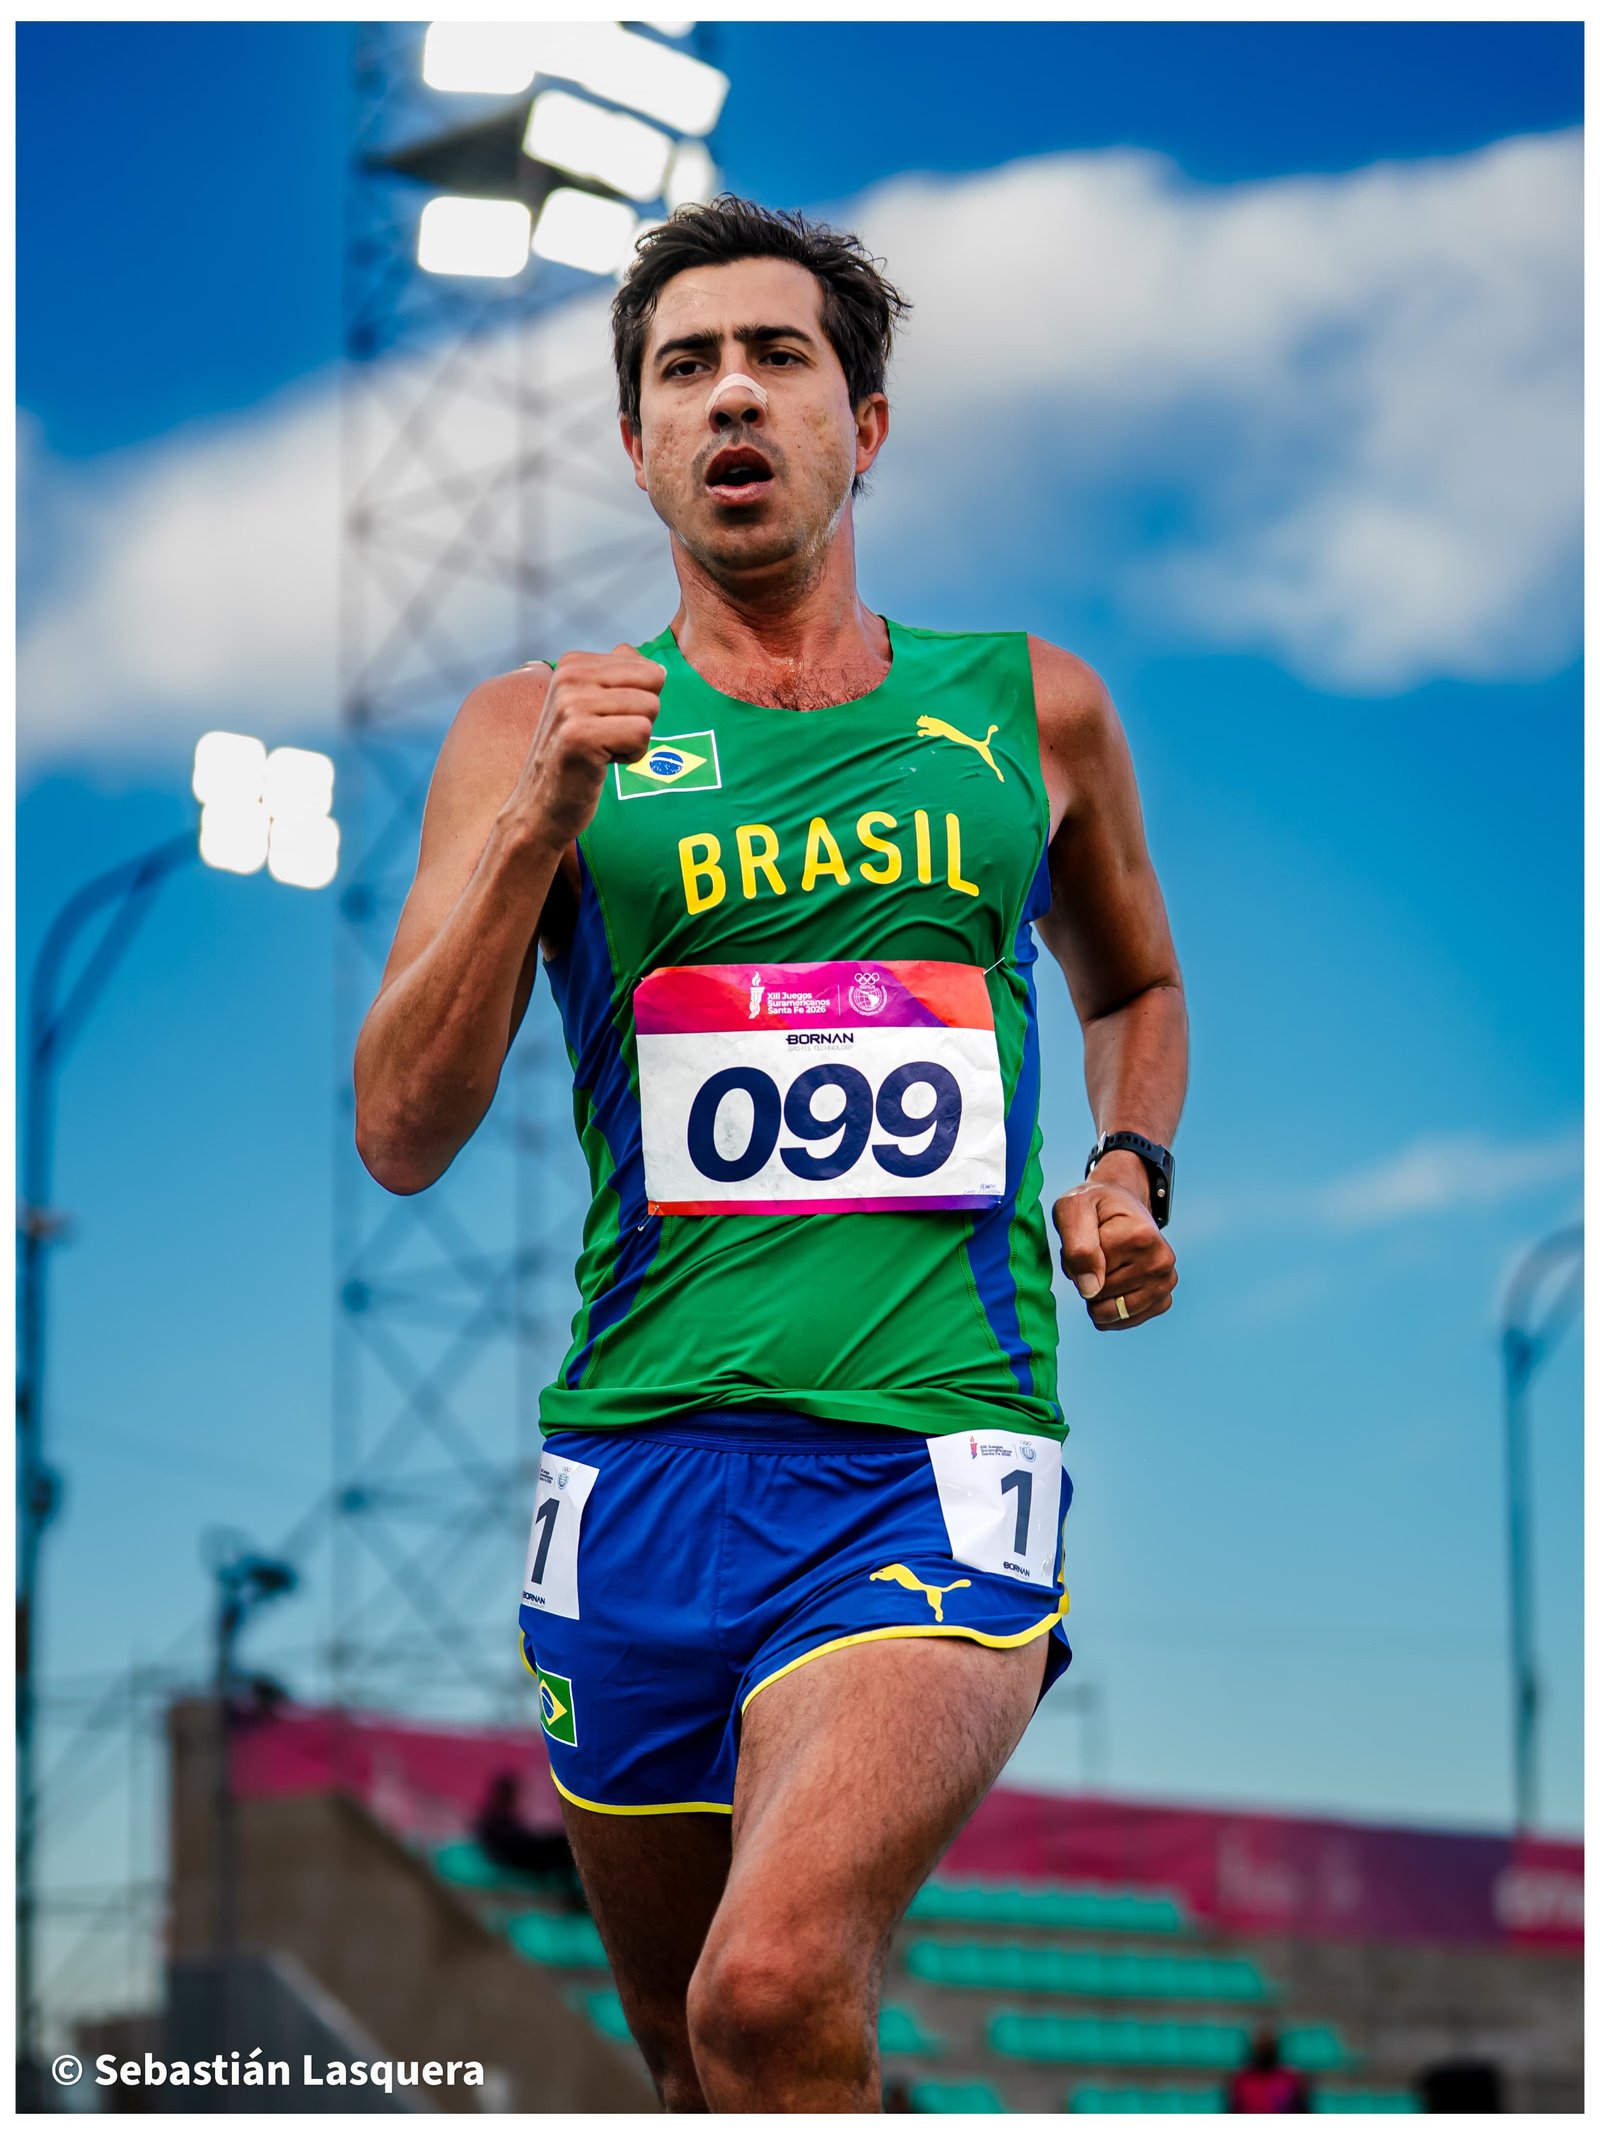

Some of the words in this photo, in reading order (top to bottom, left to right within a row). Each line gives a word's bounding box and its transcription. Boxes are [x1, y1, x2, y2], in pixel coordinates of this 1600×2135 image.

[679, 810, 980, 915] BRASIL
[767, 992, 780, 1000] XIII
[781, 992, 812, 1001] Juegos
[767, 999, 830, 1007] Suramericanos
[767, 1006, 792, 1014] Santa
[794, 1006, 804, 1014] Fe
[805, 1006, 826, 1014] 2026
[785, 1032, 854, 1045] BORNAN
[687, 1061, 962, 1183] 099
[1001, 1469, 1032, 1556] 1
[530, 1497, 560, 1585] 1
